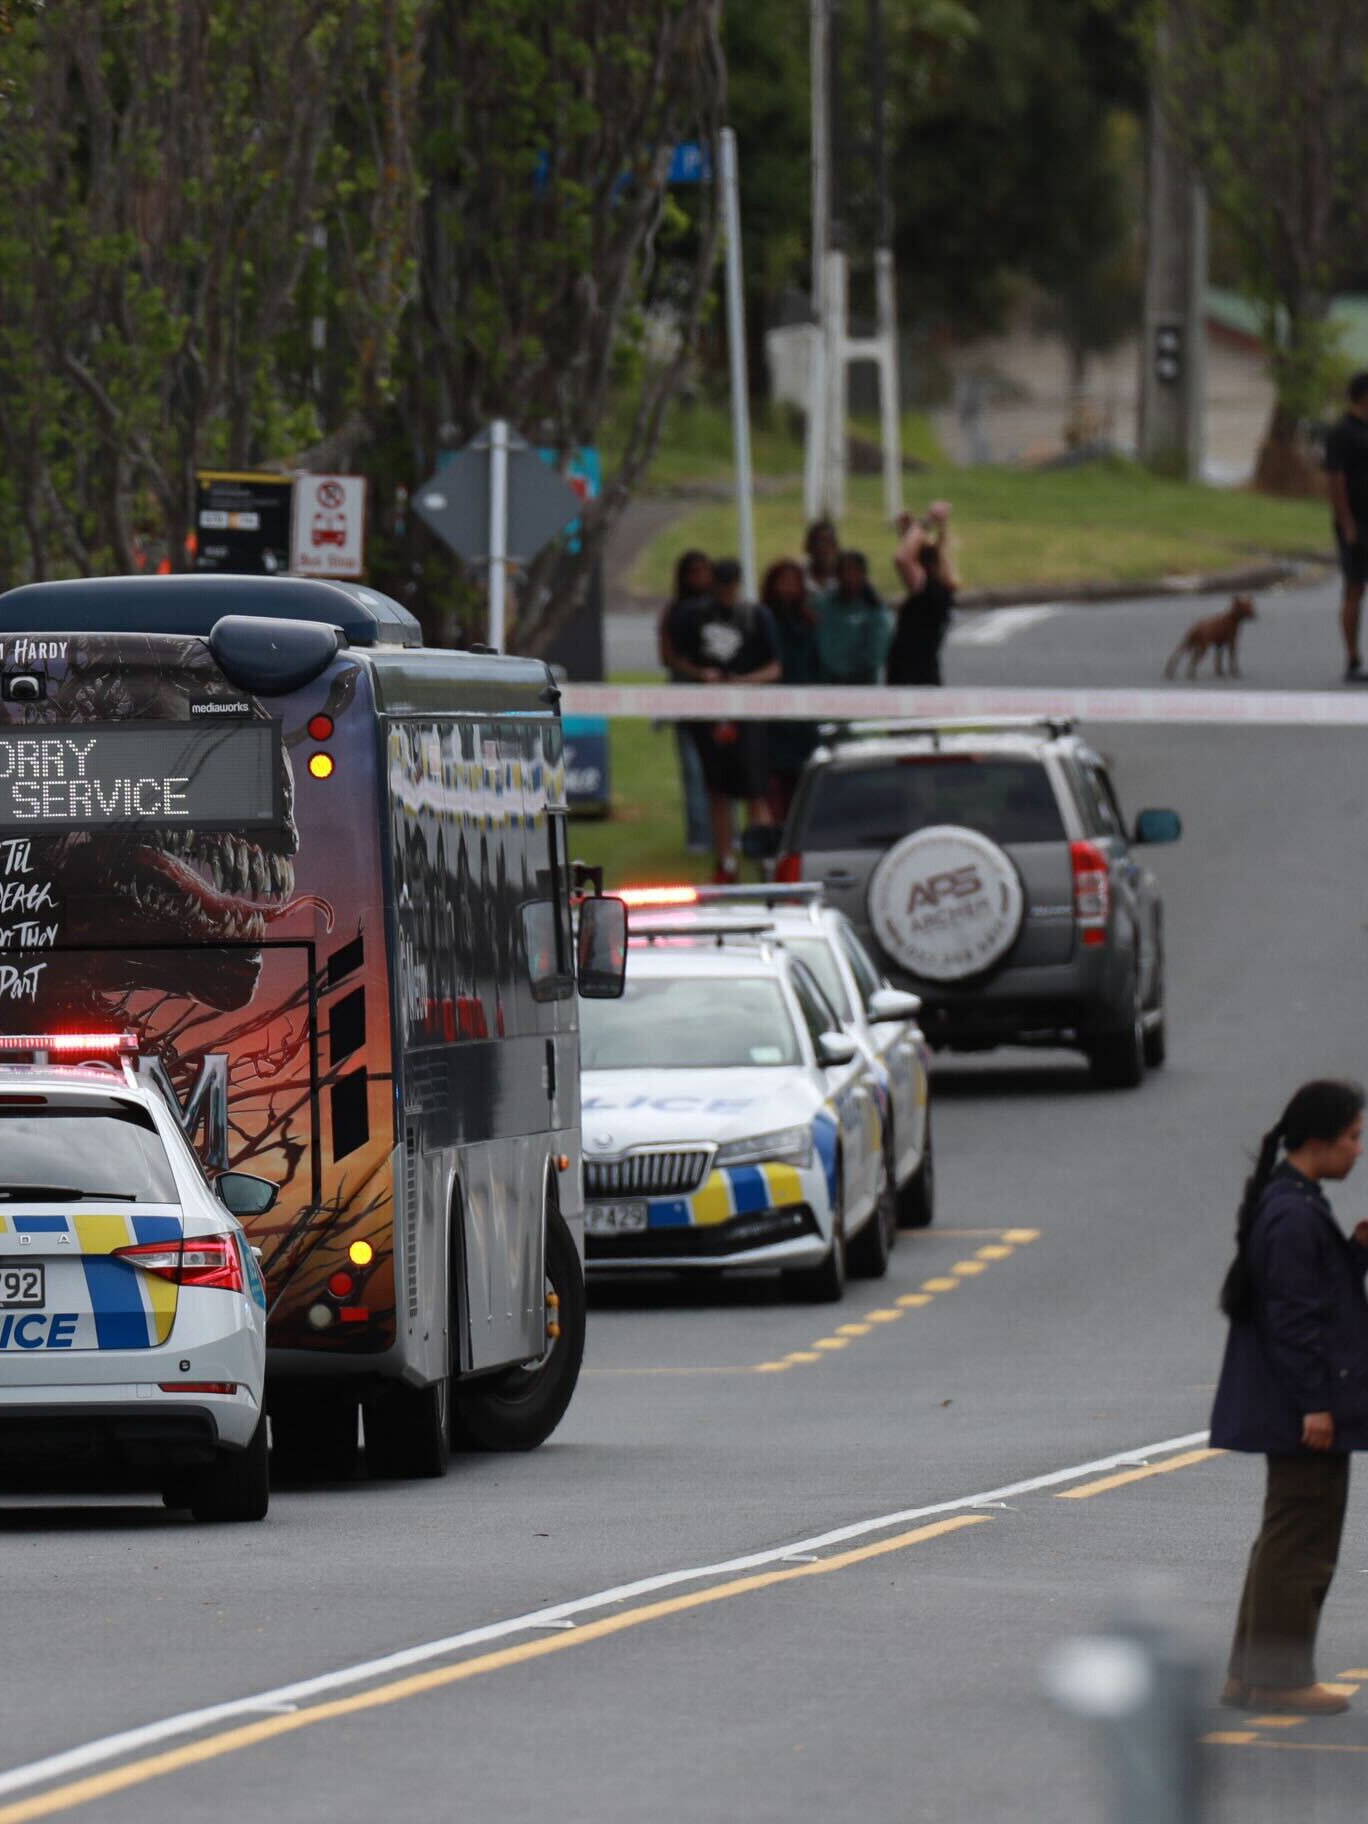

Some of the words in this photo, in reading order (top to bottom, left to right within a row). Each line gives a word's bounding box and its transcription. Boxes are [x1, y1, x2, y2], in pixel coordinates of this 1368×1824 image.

[14, 638, 68, 664] HARDY
[192, 701, 249, 714] mediaworks
[12, 777, 189, 818] SERVICE
